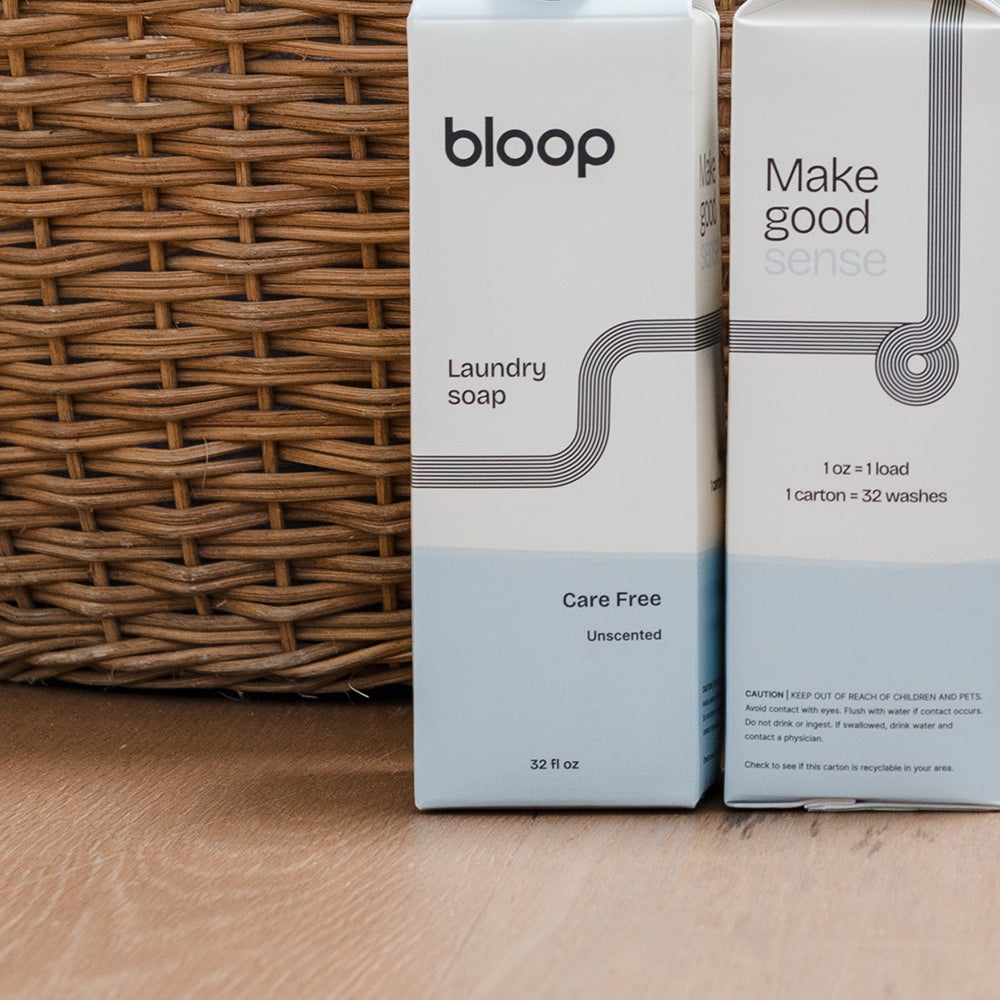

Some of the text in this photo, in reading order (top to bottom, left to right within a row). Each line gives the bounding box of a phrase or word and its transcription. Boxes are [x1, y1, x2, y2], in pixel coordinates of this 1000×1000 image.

[444, 116, 616, 178] bloop
[767, 157, 879, 194] Make
[764, 198, 870, 242] good
[764, 247, 887, 277] sense
[448, 357, 547, 382] Laundry
[448, 388, 507, 410] soap
[823, 461, 829, 475] 1
[832, 463, 852, 475] oz
[866, 462, 872, 475] 1
[875, 461, 910, 476] load
[786, 487, 792, 501] 1
[794, 489, 847, 502] carton
[862, 489, 882, 503] 32
[885, 489, 948, 504] washes
[562, 592, 662, 608] Care Free
[586, 629, 662, 642] Unscented
[745, 689, 784, 699] CAUTION
[791, 691, 812, 699] KEEP
[814, 692, 832, 700] OUT
[834, 692, 846, 700] OF
[849, 692, 877, 701] REACH
[879, 693, 891, 701] OF
[893, 693, 936, 701] CHILDREN
[938, 693, 957, 701] AND
[959, 693, 983, 701] PETS.
[745, 704, 767, 712] Avoid
[769, 705, 799, 713] contact
[801, 706, 819, 714] with
[820, 708, 842, 716] eyes.
[844, 707, 866, 715] Flush
[868, 707, 885, 715] with
[913, 707, 919, 715] if
[745, 718, 756, 726] Do
[758, 719, 771, 727] not
[773, 719, 793, 728] drink
[806, 720, 832, 730] ingest.
[843, 721, 888, 730] swallowed,
[890, 721, 910, 729] drink
[937, 721, 953, 729] and
[745, 733, 774, 741] contact
[784, 734, 823, 743] physician.
[530, 758, 580, 770] 32 fl oz
[744, 760, 770, 769] Check
[799, 762, 804, 770] if
[823, 763, 849, 771] carton
[852, 763, 858, 771] is
[861, 763, 901, 773] recyclable
[904, 763, 911, 771] in
[913, 765, 931, 773] your
